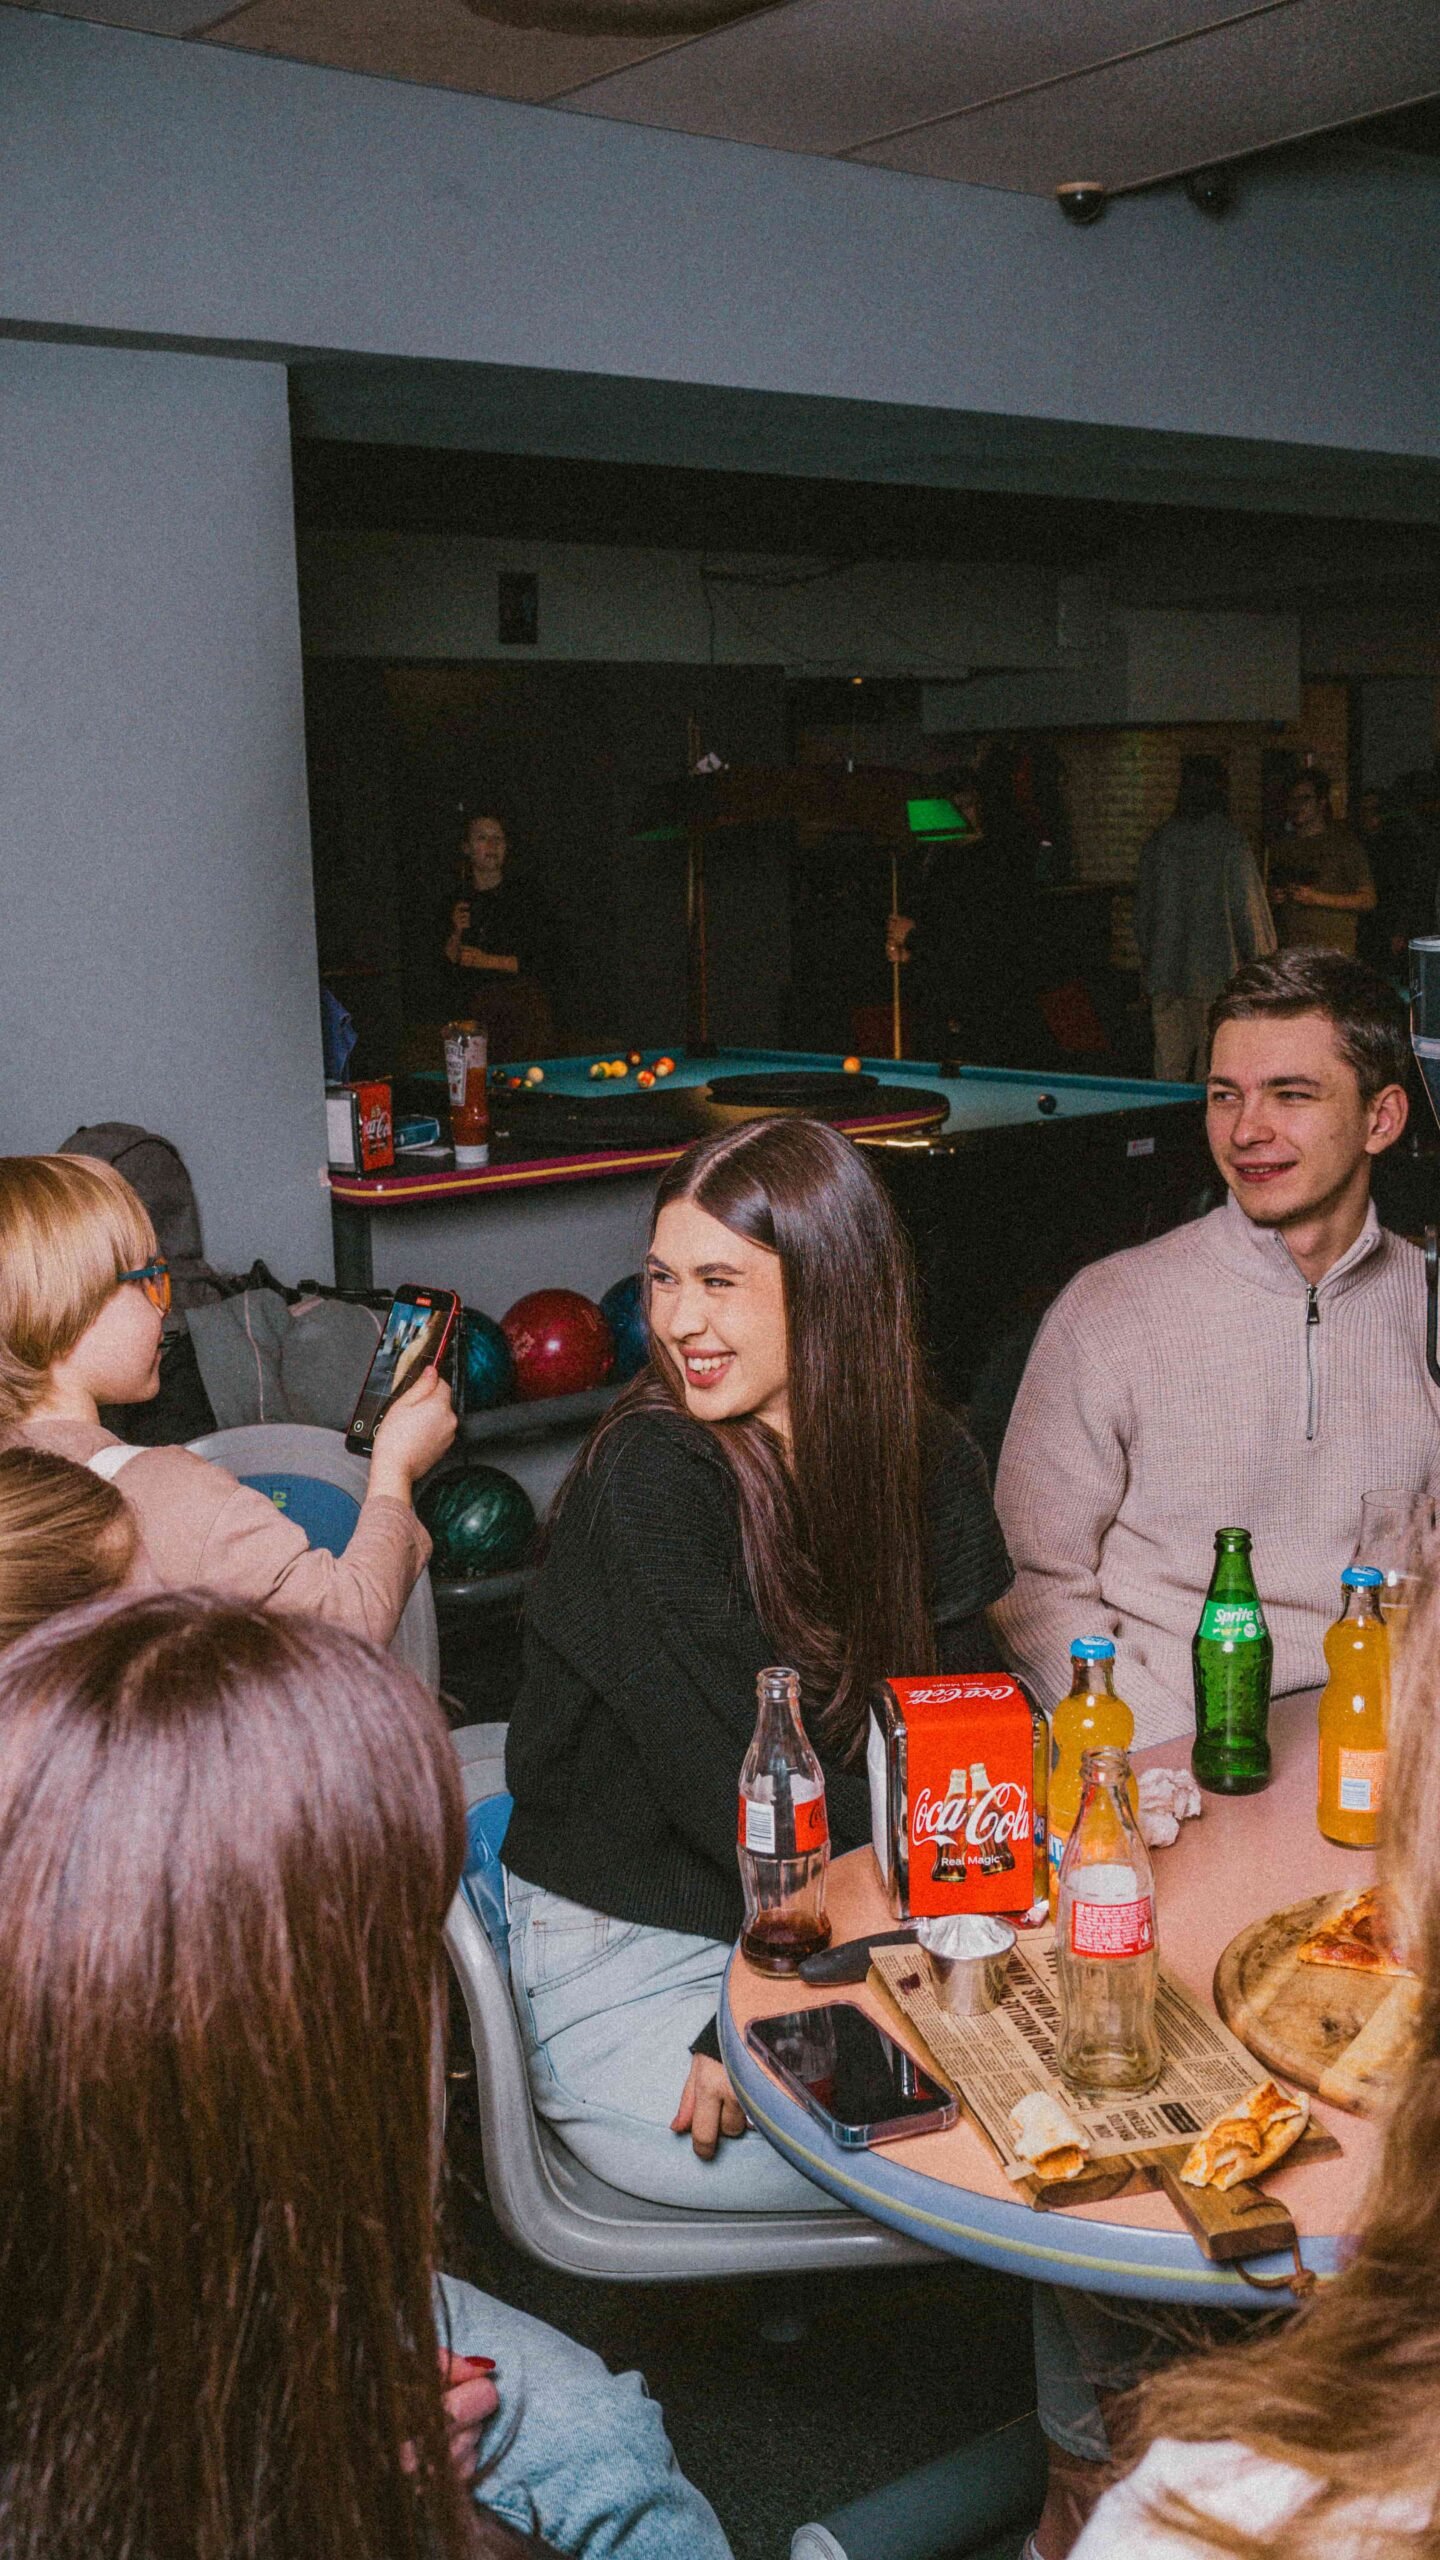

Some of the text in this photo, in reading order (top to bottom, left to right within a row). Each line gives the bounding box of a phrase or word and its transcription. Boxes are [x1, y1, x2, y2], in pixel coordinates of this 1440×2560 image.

[1214, 1607, 1254, 1626] Sprite
[905, 1685, 1014, 1705] Coca-Cola
[912, 1782, 1030, 1847] Coca-Cola
[941, 1855, 1000, 1867] Real Magic
